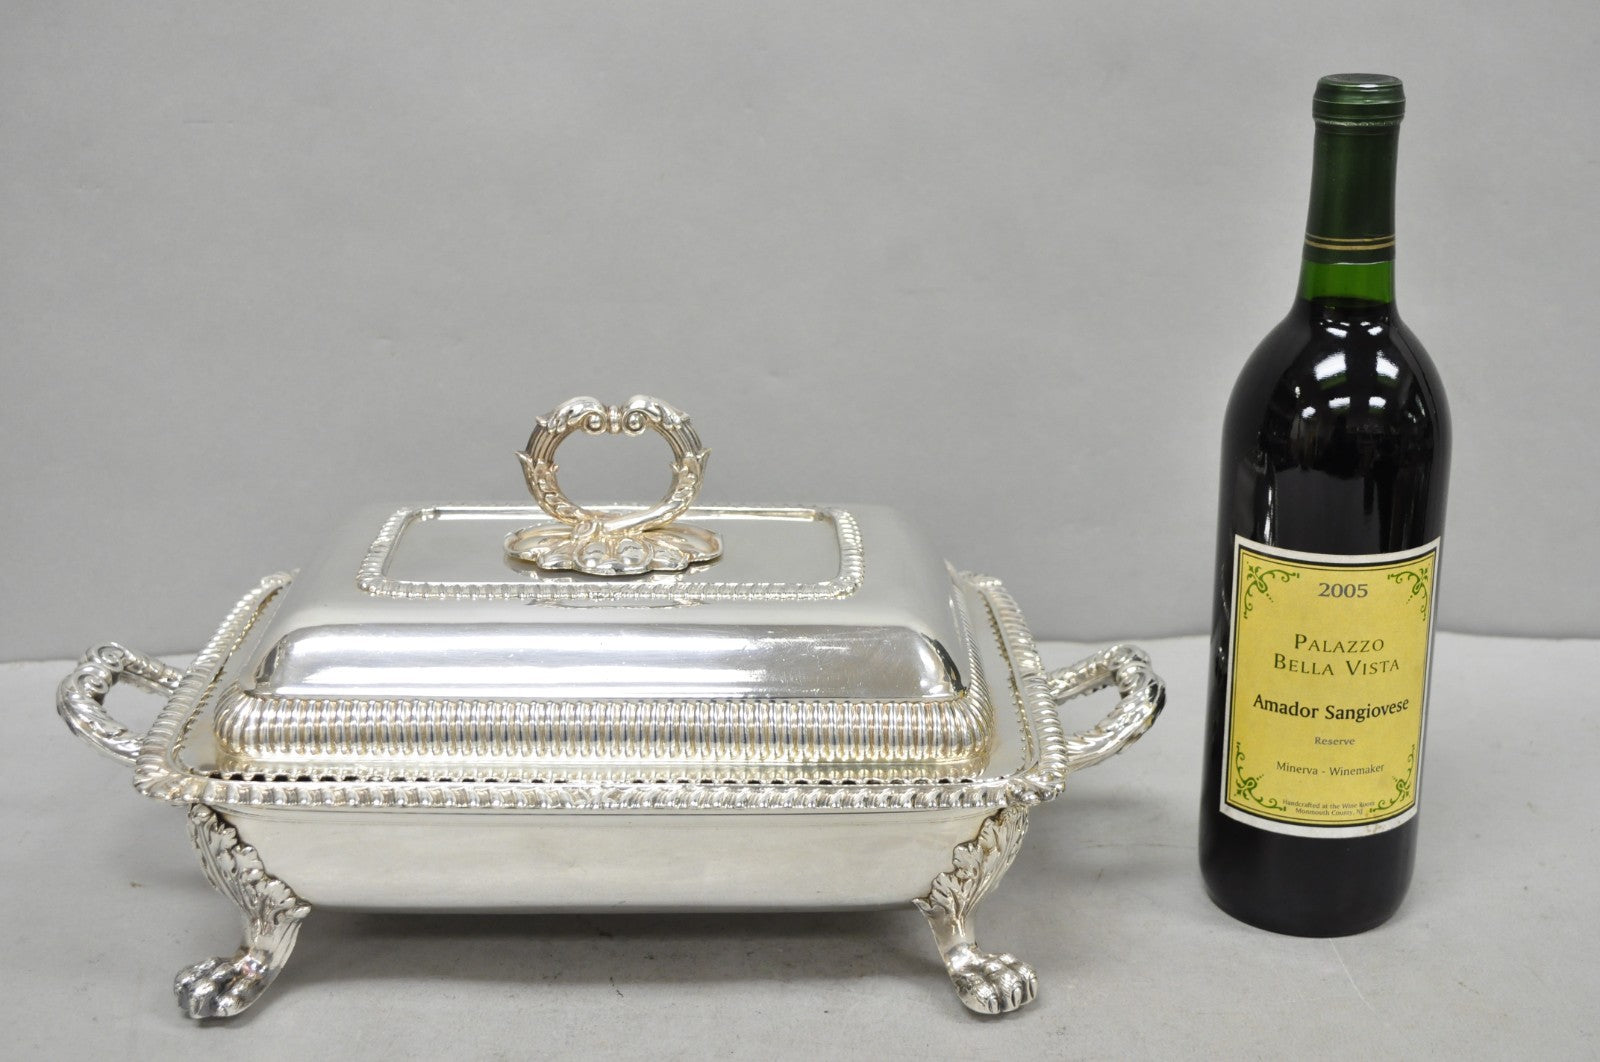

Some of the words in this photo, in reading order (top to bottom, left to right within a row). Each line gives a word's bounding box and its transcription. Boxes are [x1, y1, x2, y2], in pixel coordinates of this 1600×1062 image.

[1318, 583, 1368, 598] 2005
[1295, 633, 1385, 653] PALAZZO
[1274, 653, 1334, 675] BELLA
[1346, 659, 1399, 675] VISTA
[1253, 694, 1319, 719] Amador
[1325, 699, 1409, 723] Sangiovese
[1314, 736, 1356, 746] Reserve
[1276, 761, 1318, 775] Minerva
[1329, 763, 1385, 776] Winemaker
[1282, 799, 1321, 809] Handcrafted
[1295, 807, 1330, 816] Monmouth
